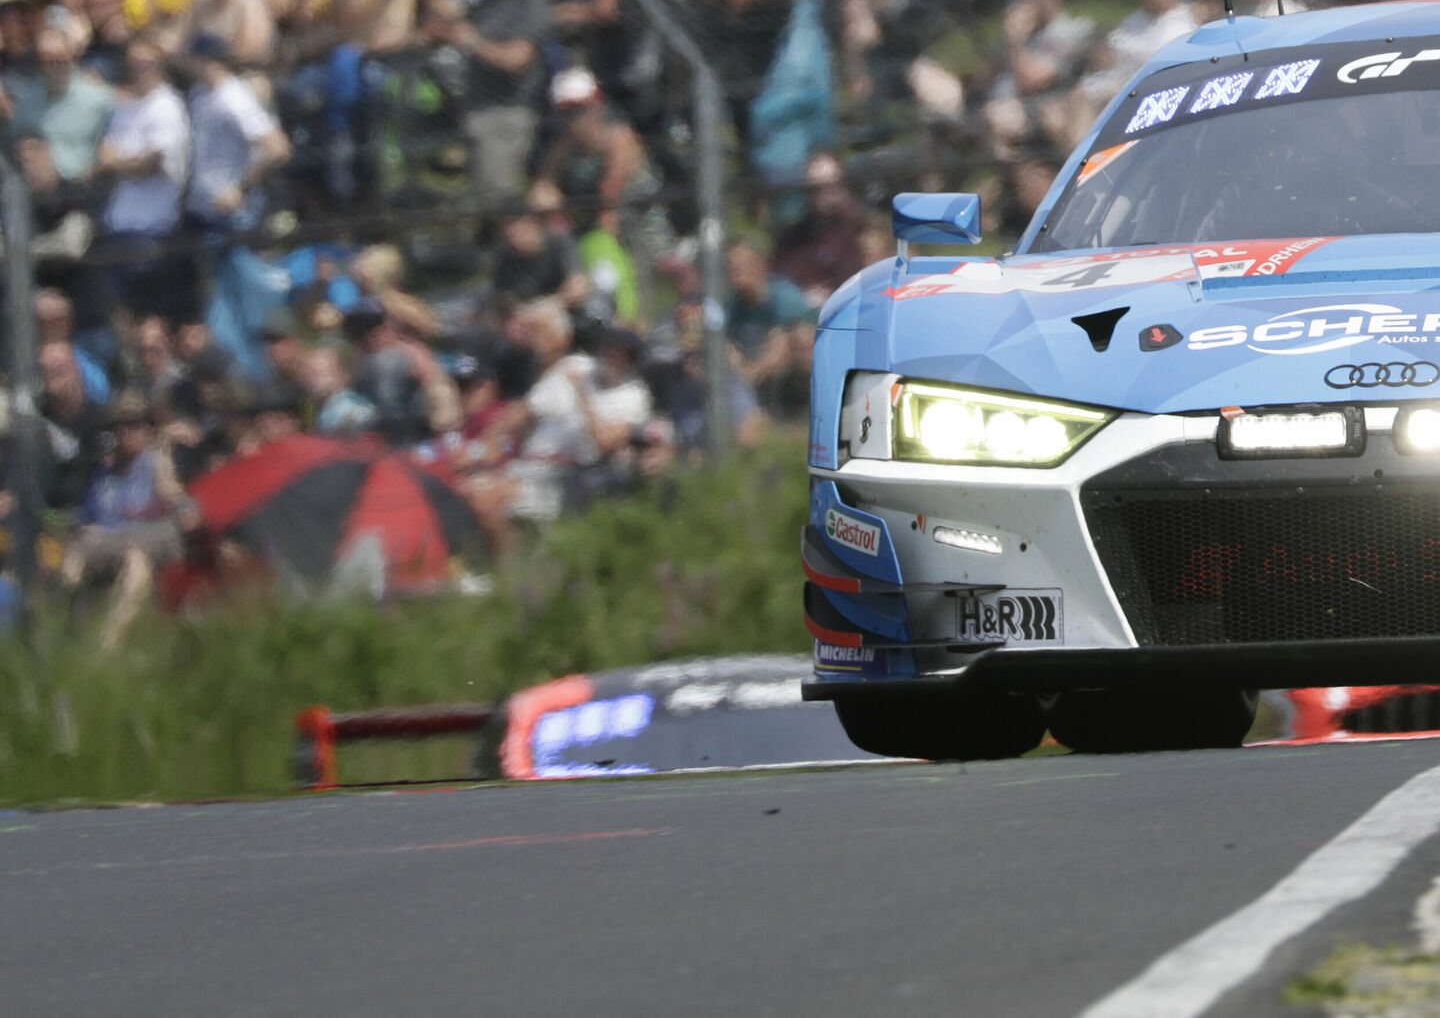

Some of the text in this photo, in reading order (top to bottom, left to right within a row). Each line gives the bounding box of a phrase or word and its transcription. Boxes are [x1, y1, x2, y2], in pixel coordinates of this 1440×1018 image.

[1042, 262, 1121, 288] 4
[1377, 333, 1429, 345] Autos
[835, 512, 877, 553] Castrol
[959, 596, 1018, 638] H&R
[819, 644, 876, 664] MICHELIN
